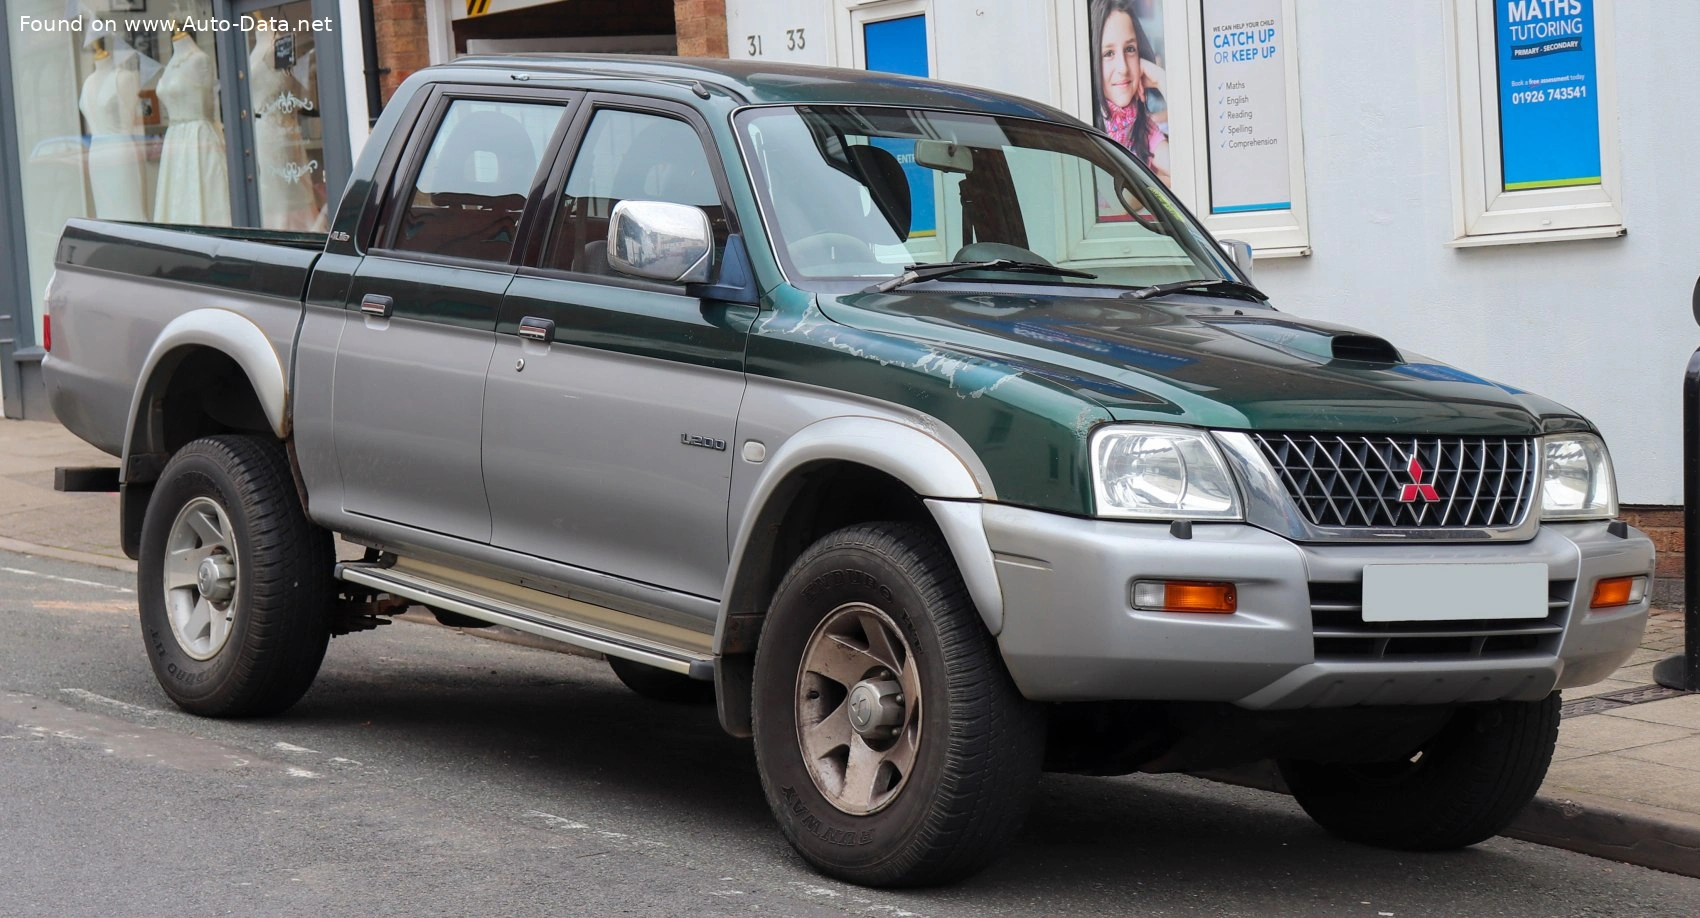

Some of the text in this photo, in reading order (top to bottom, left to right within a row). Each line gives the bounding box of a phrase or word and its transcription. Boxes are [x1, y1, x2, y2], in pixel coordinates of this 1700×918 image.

[1508, 0, 1582, 22] MATHS
[1260, 19, 1274, 27] CHILD
[1509, 18, 1583, 40] TUTORING
[747, 28, 806, 56] 31 33
[1213, 28, 1275, 48] CATCH UP
[1213, 46, 1276, 64] OR KEEP UP
[1514, 47, 1540, 56] PRIMARY
[1543, 41, 1579, 52] SECONDARY
[1225, 81, 1245, 90] Maths
[1512, 85, 1586, 104] 01926 743541
[1226, 95, 1249, 107] English
[1227, 110, 1253, 120] Reading
[1227, 125, 1253, 137] Spelling
[1228, 137, 1278, 149] Comprehension
[681, 433, 726, 451] L200
[780, 785, 876, 848] RUNWAY
